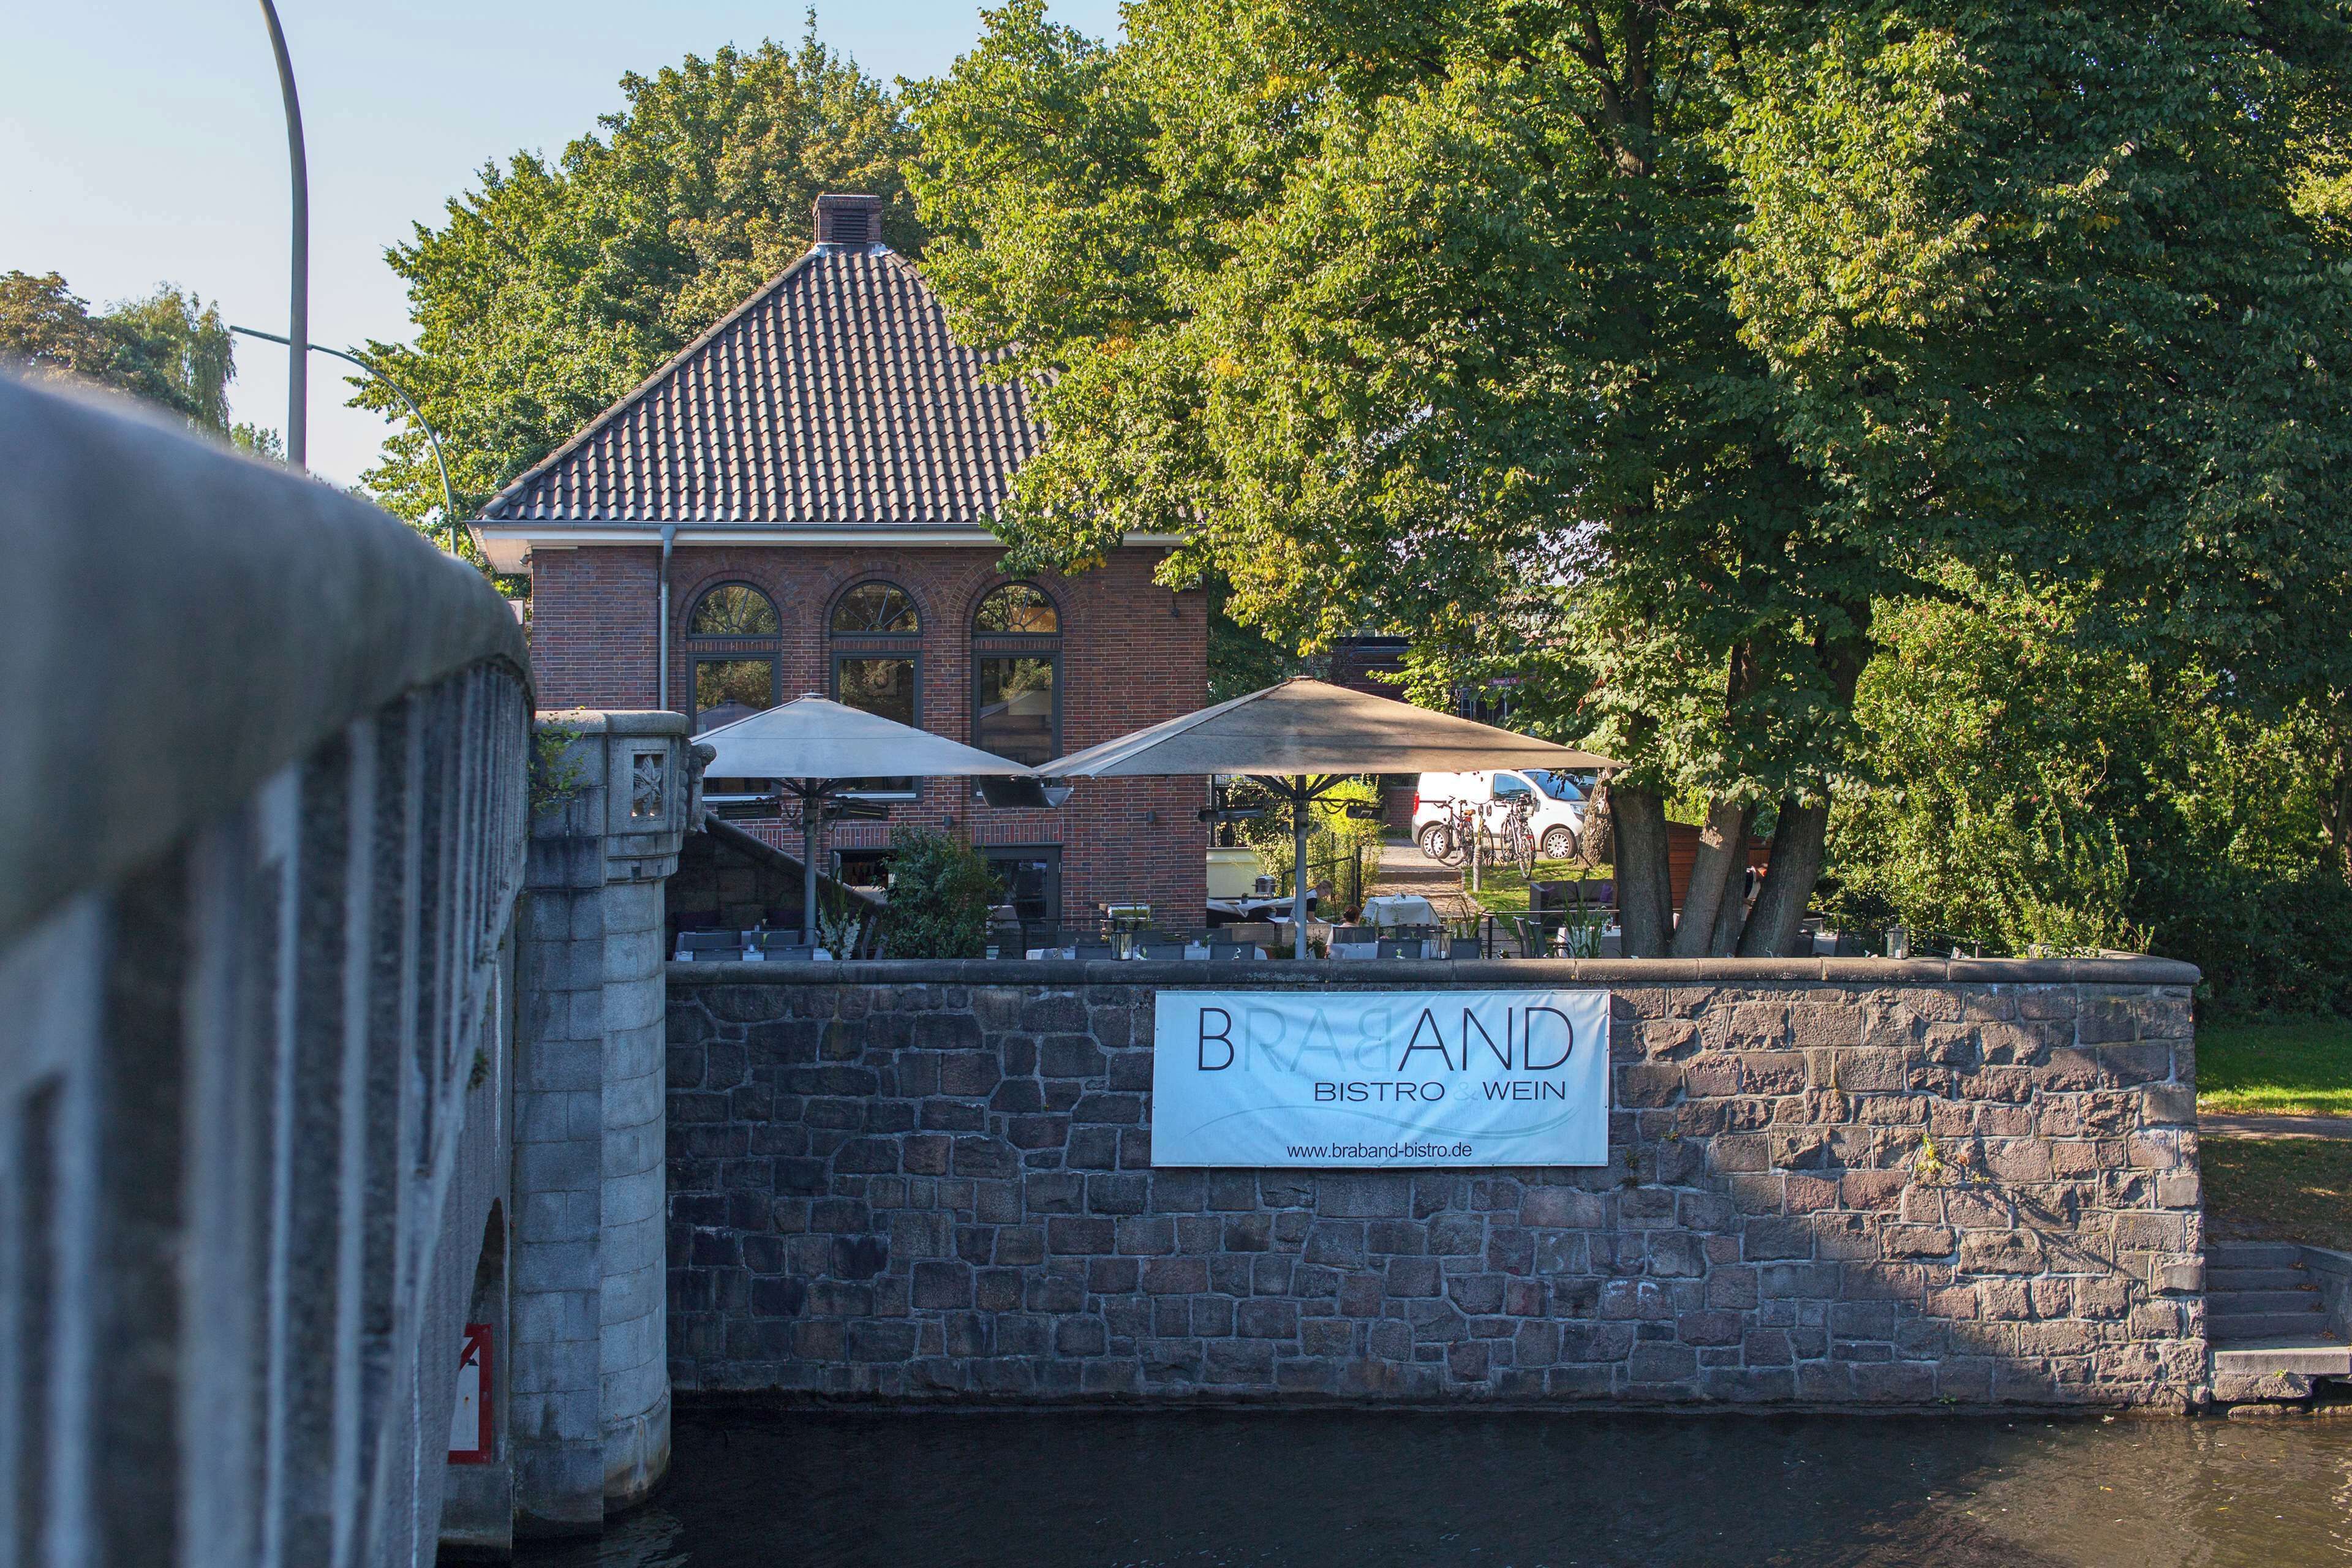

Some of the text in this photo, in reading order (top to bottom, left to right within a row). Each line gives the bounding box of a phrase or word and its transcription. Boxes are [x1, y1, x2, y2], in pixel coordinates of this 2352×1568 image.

[1197, 1007, 1574, 1072] BRABAND
[1314, 1080, 1566, 1102] BISTRO & WEIN
[1286, 1142, 1472, 1158] www.braband-bistro.de
